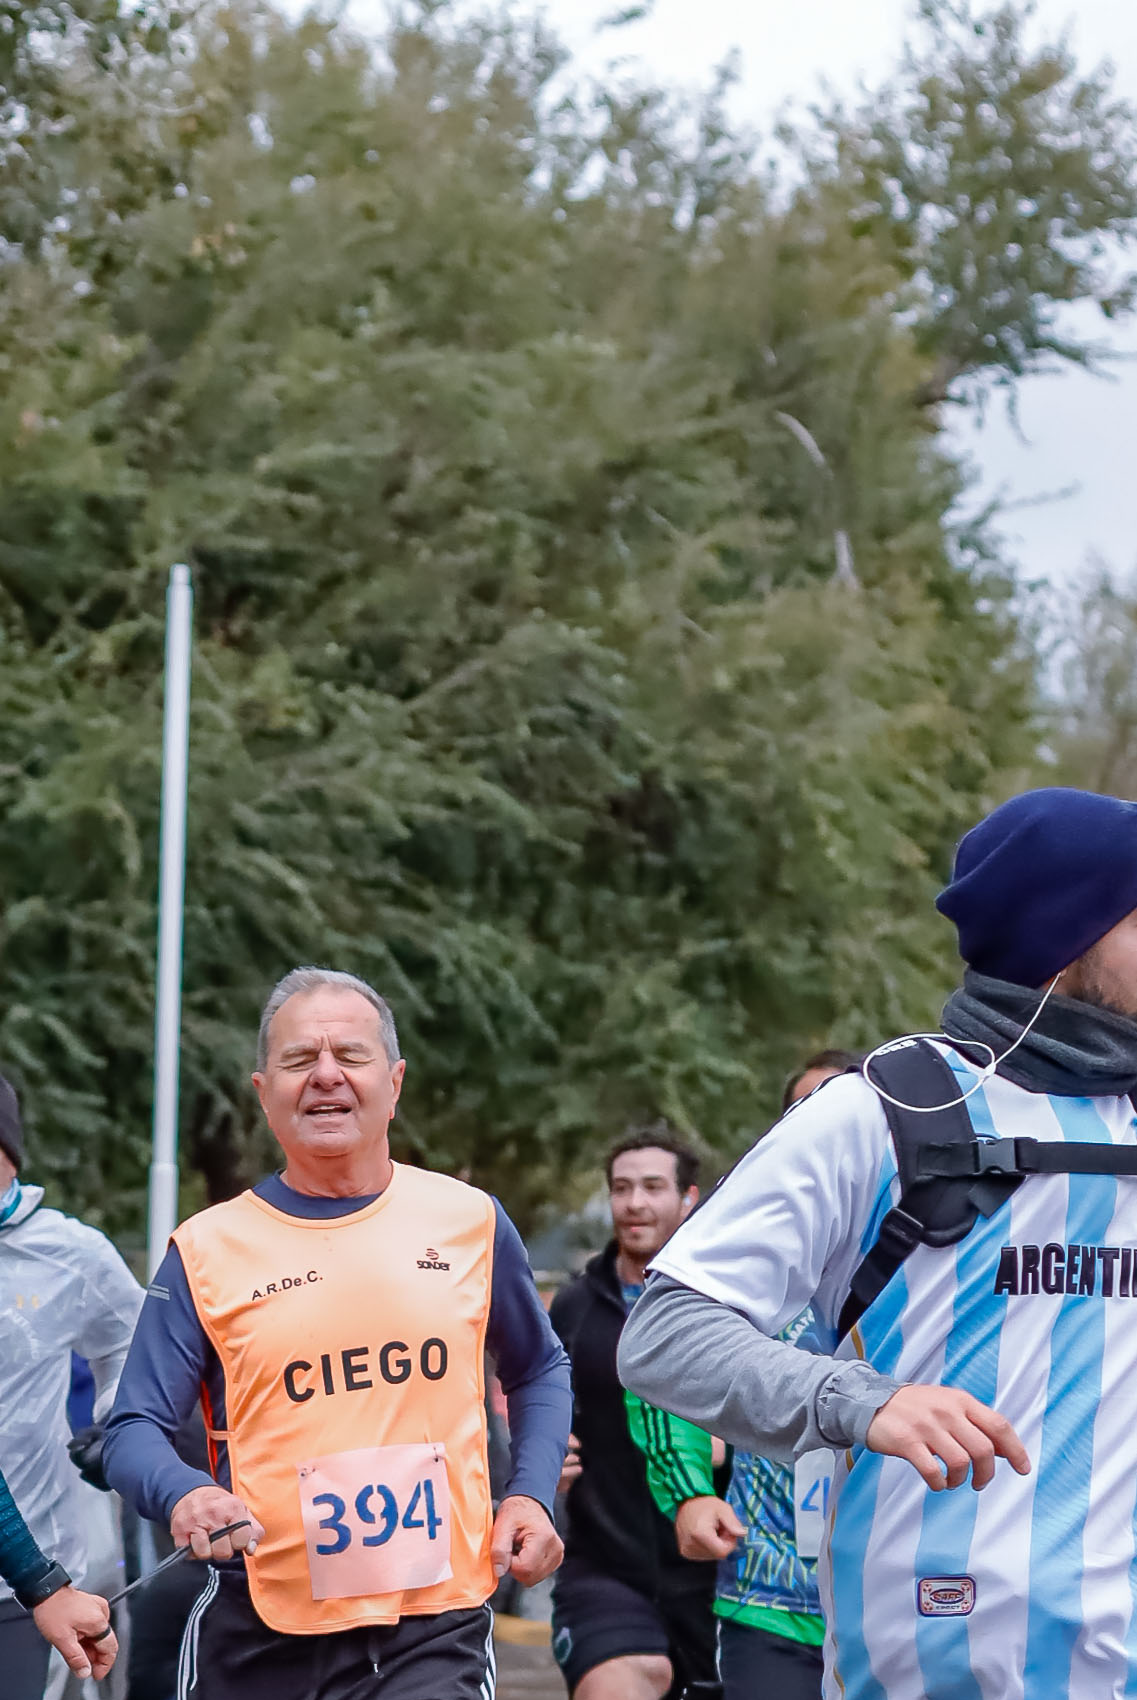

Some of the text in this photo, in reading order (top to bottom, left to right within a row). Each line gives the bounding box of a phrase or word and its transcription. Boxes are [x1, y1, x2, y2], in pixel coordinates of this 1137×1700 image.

[252, 1271, 323, 1301] A.R.De.C.
[993, 1243, 1137, 1297] ARGENTI
[284, 1337, 448, 1402] CIEGO
[311, 1478, 443, 1555] 394
